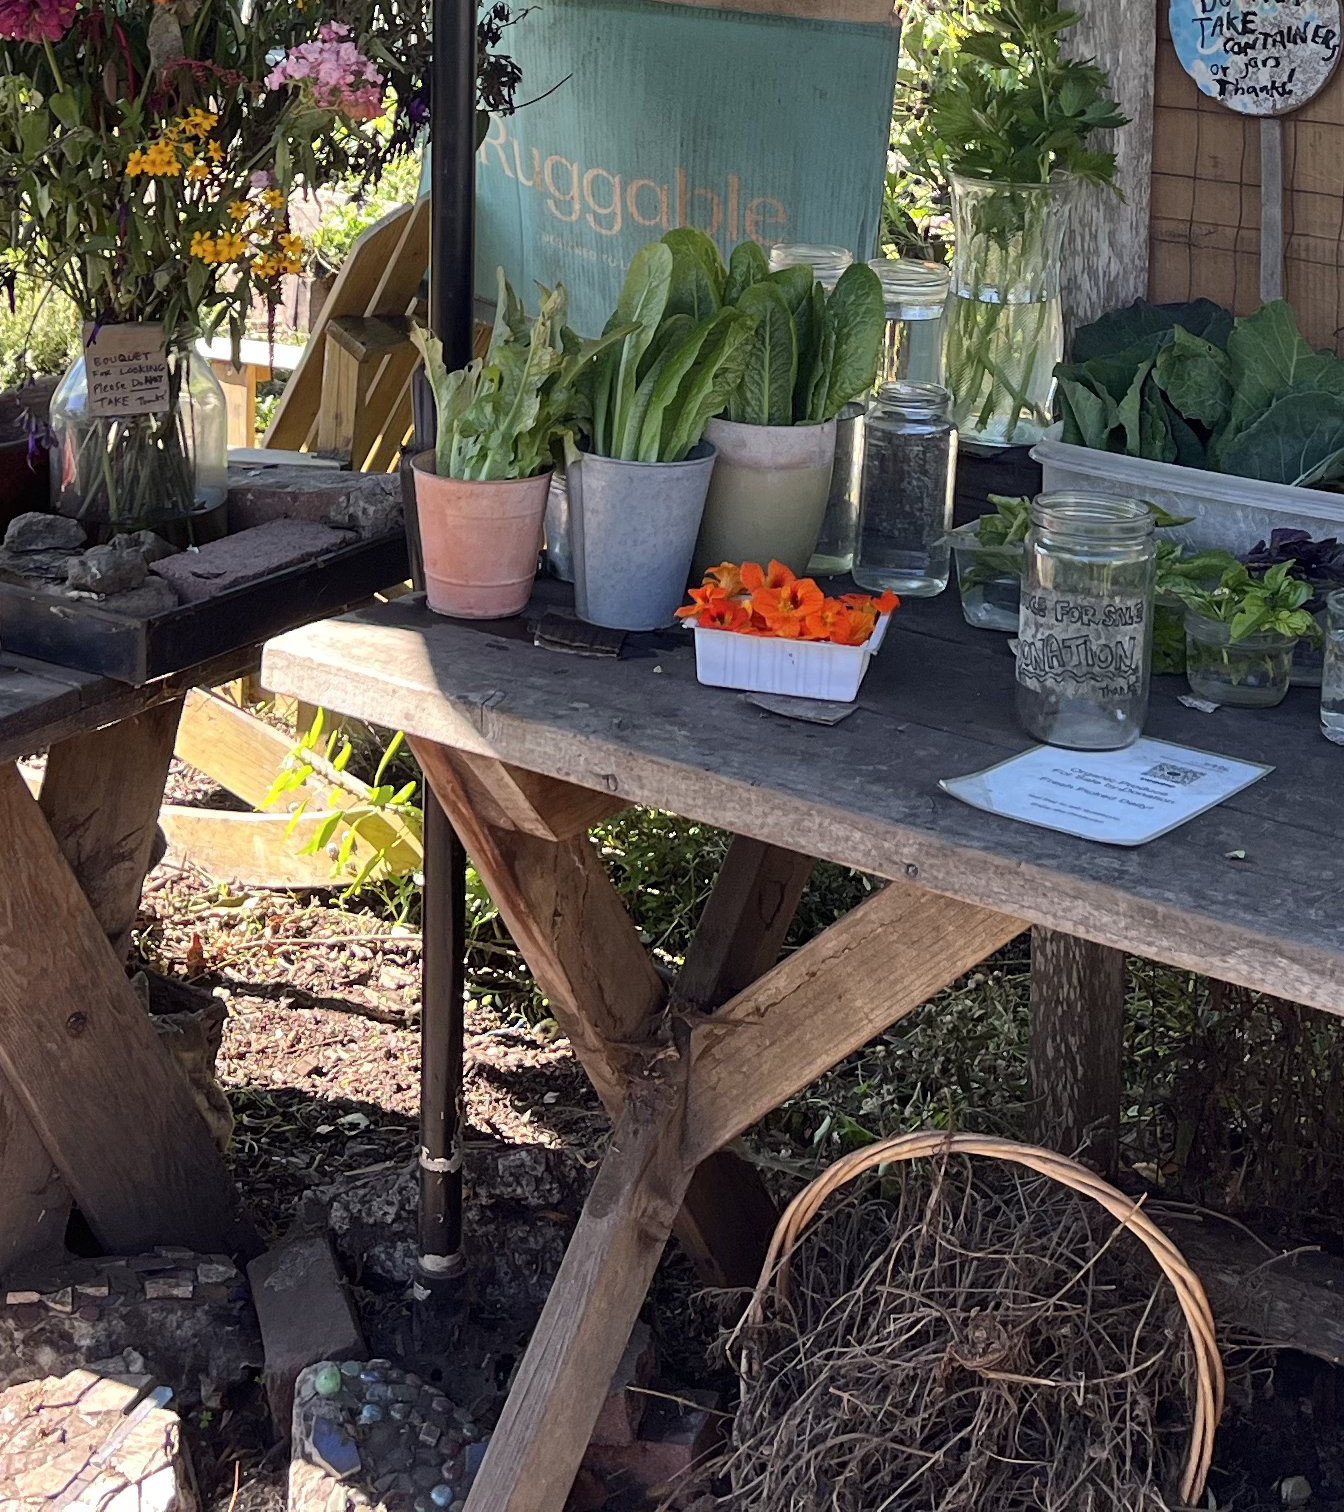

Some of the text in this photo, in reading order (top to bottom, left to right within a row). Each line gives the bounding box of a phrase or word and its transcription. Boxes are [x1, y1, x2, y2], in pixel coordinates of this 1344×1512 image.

[1192, 11, 1258, 49] TAKE
[1210, 55, 1281, 79] or jars
[476, 110, 787, 246] Ruggable
[93, 351, 152, 367] BOUQUET
[120, 363, 166, 376] LOOKING
[94, 395, 130, 409] TAKE
[1054, 599, 1100, 627] FOR
[1101, 600, 1144, 627] SALE
[1019, 633, 1137, 673] ONATION
